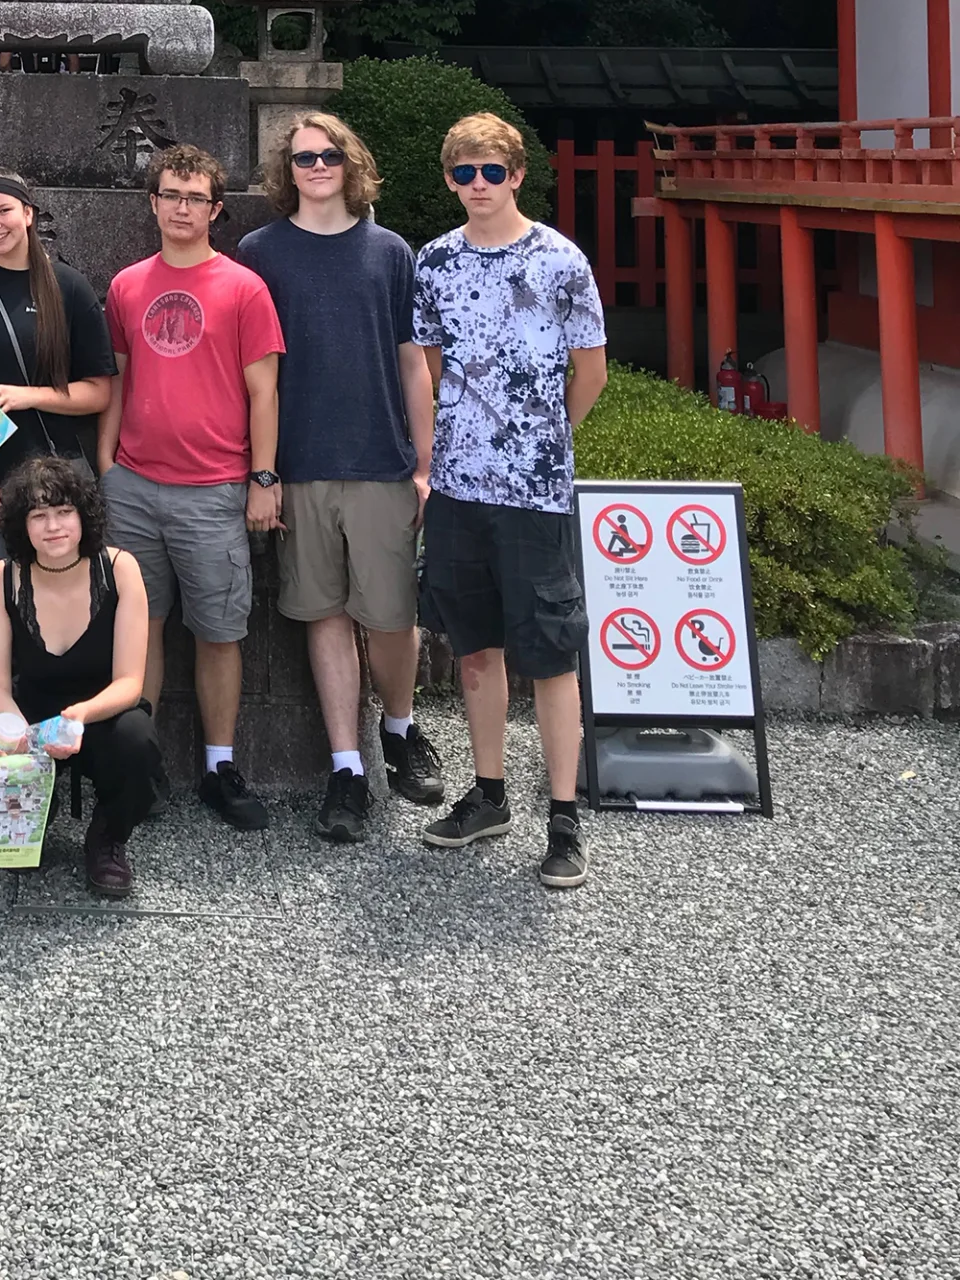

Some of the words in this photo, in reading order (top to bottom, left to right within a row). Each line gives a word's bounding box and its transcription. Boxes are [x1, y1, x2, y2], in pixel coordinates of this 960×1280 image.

[95, 87, 180, 170] 奉
[180, 295, 202, 321] CAVERNS
[177, 339, 195, 353] PARK
[626, 681, 651, 689] Smoking
